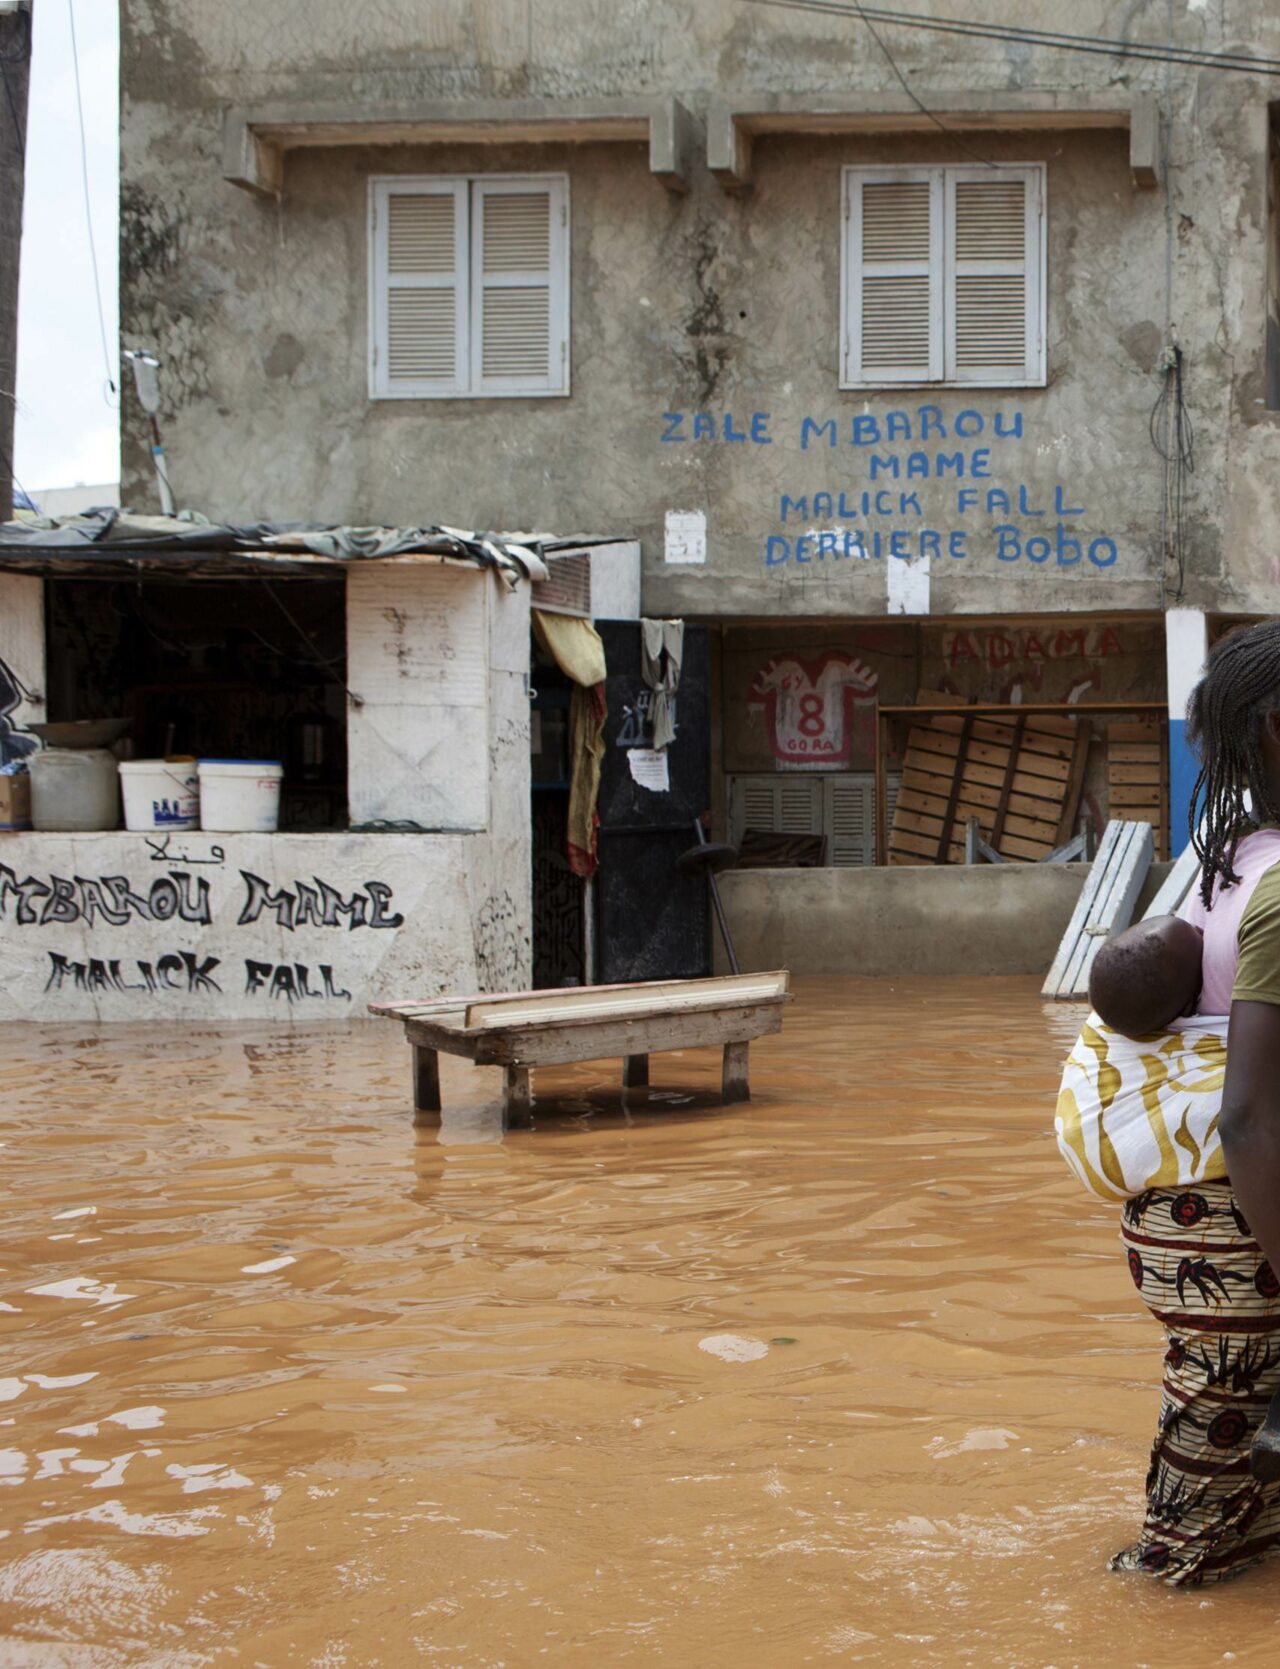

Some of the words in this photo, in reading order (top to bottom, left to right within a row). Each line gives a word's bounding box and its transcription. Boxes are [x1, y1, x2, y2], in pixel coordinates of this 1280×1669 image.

[660, 411, 773, 444] ZALE
[870, 448, 992, 481] MAME
[780, 490, 922, 522] MALICK
[957, 484, 1086, 517] FALL
[765, 528, 968, 567] DERRIERE
[950, 625, 1125, 668] ADAMA
[796, 692, 826, 738] 8
[237, 867, 405, 932] MAME
[44, 949, 223, 995] MALICK
[244, 957, 353, 1002] FALL
